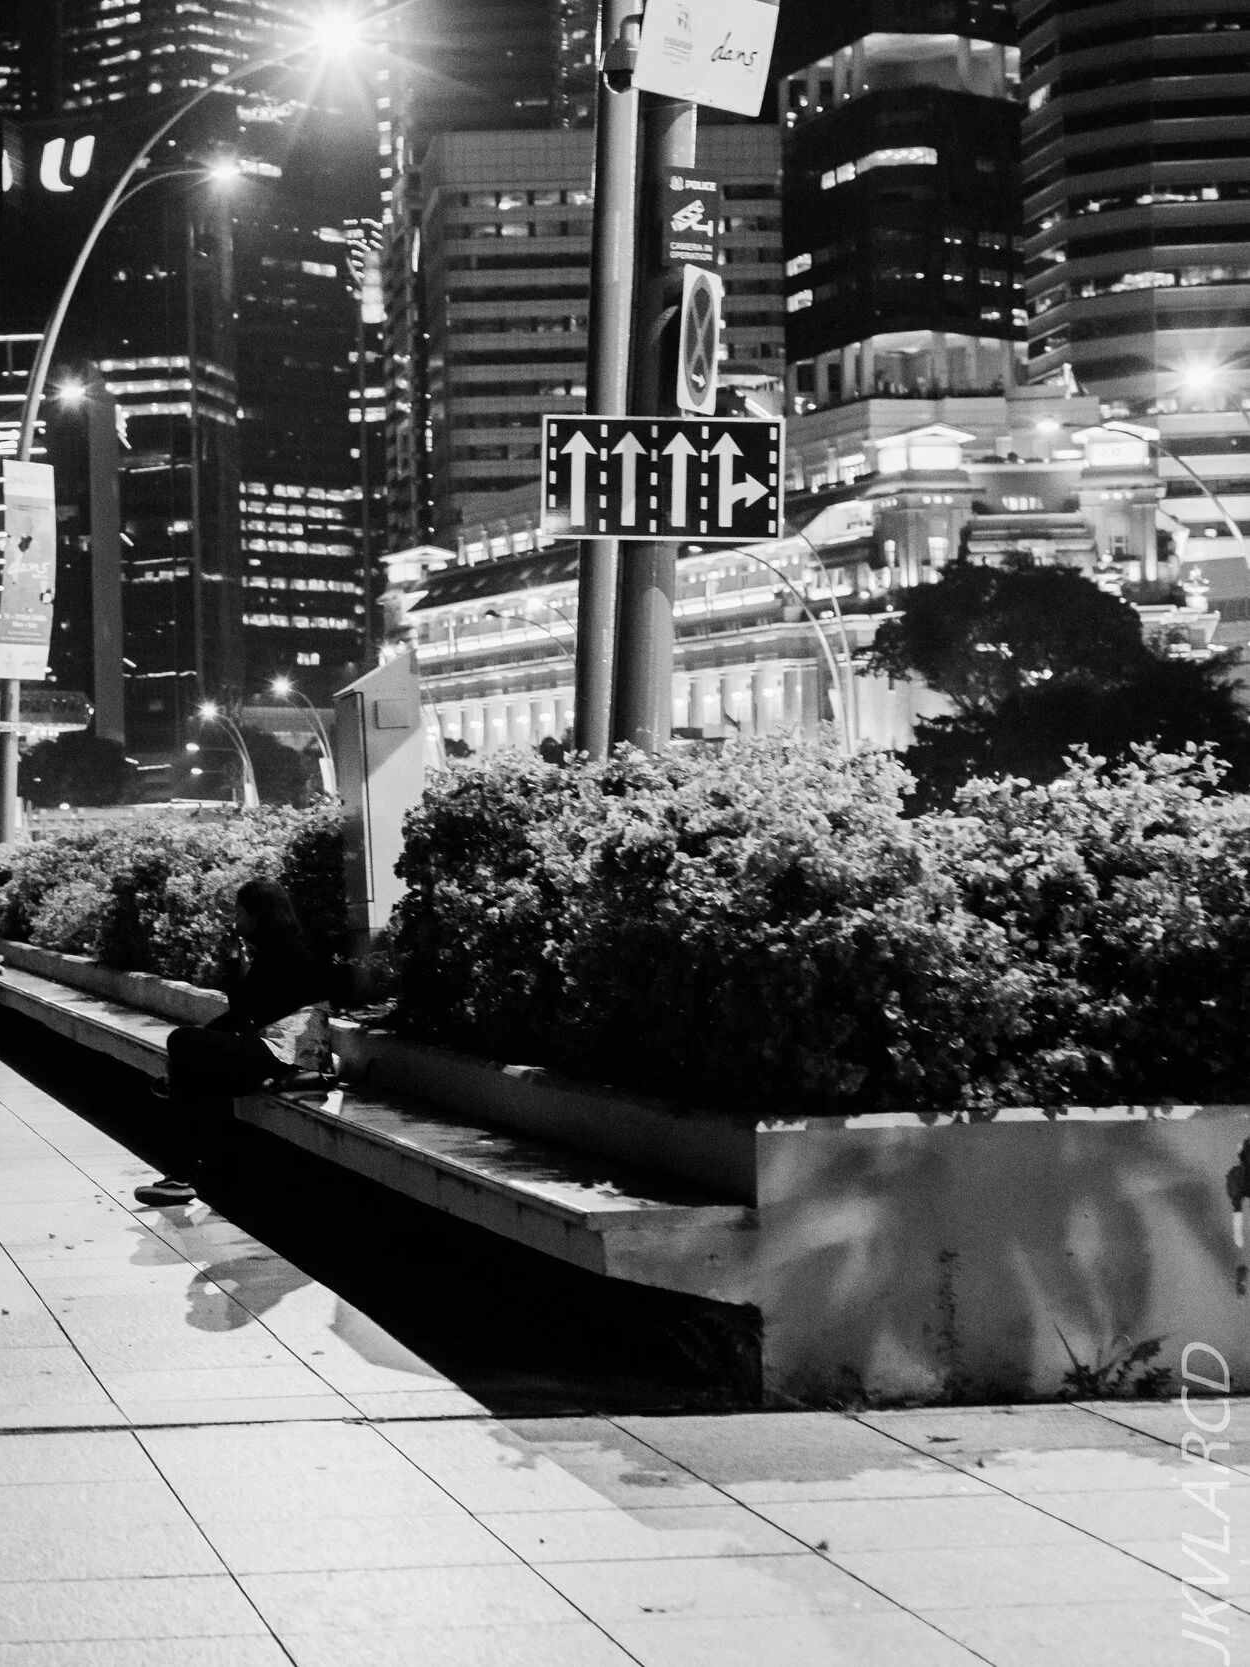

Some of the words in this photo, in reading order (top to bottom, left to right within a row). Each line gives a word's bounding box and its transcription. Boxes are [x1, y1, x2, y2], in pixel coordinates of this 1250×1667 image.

[685, 179, 717, 191] POLICE
[670, 241, 702, 251] CAMERA
[703, 244, 713, 253] IN
[669, 250, 713, 261] OPERATION
